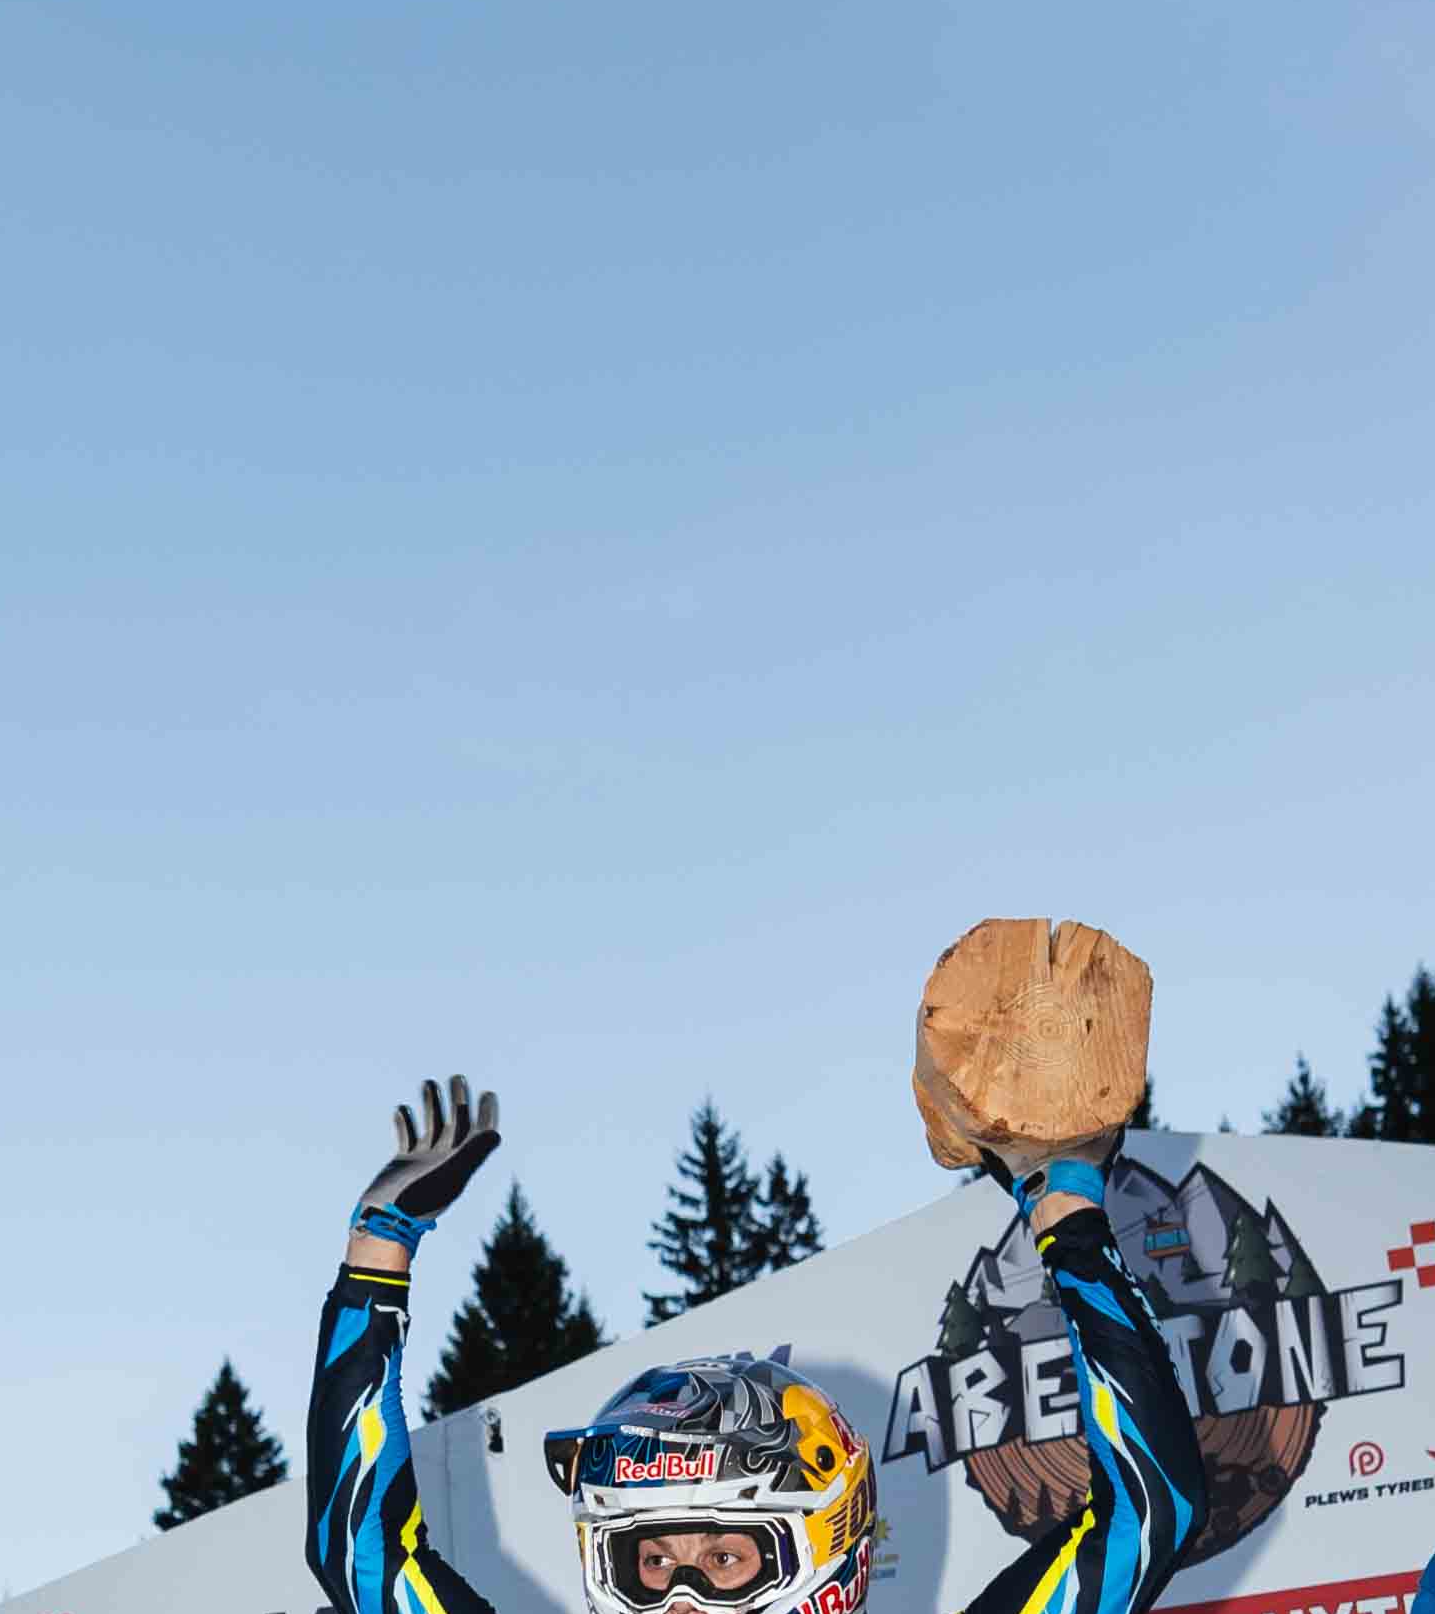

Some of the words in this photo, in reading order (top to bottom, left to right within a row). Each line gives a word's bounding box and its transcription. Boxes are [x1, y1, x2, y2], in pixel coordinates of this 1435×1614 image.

[881, 1278, 1405, 1474] ABETONE
[615, 1453, 663, 1482] Red
[665, 1451, 715, 1478] Bull
[1305, 1486, 1369, 1508] PLEWS
[1375, 1476, 1435, 1498] TYRES
